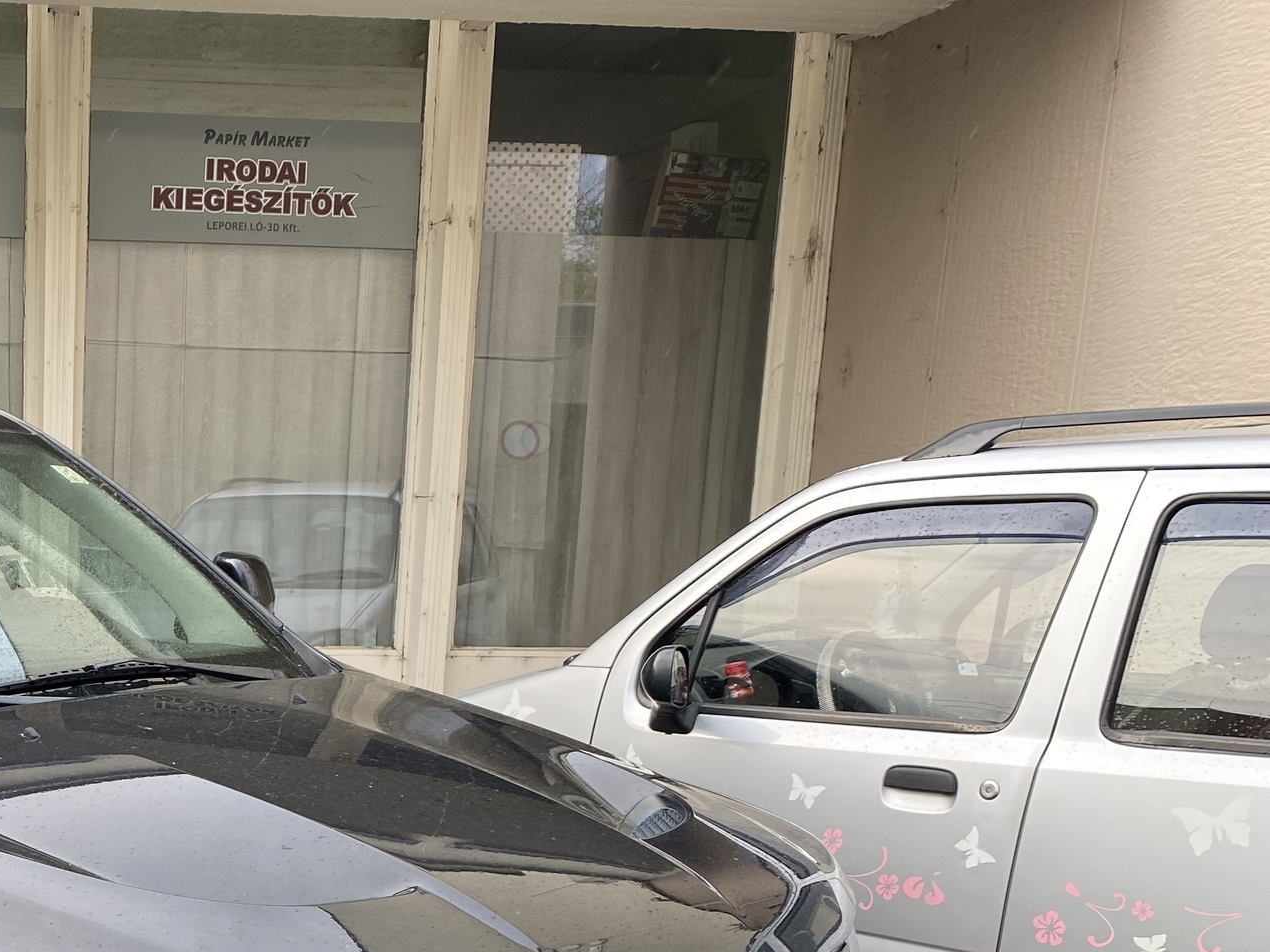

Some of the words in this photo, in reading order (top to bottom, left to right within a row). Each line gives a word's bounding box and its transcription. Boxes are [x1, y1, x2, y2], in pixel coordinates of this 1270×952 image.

[251, 130, 311, 148] MARKET
[204, 157, 308, 185] IRODAI
[151, 184, 359, 218] KIEGÉSZÍTŐK
[282, 223, 300, 233] Kft.
